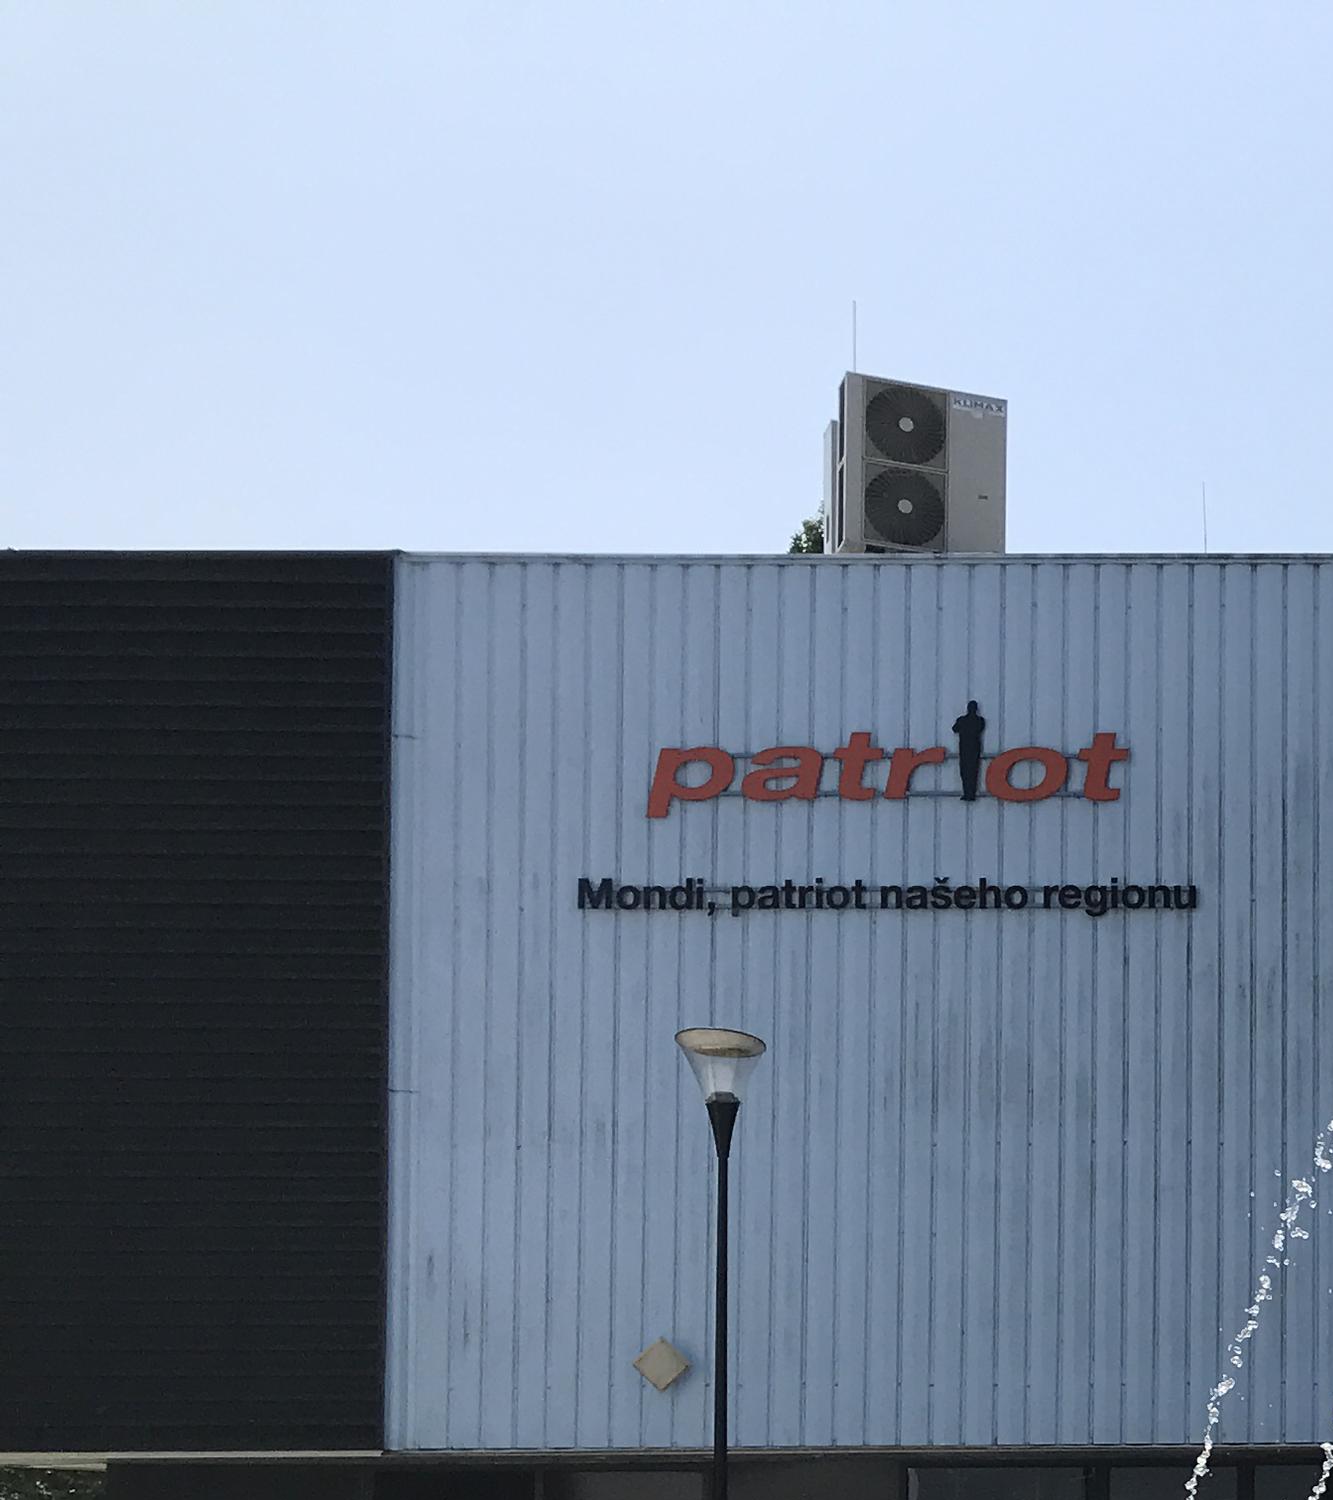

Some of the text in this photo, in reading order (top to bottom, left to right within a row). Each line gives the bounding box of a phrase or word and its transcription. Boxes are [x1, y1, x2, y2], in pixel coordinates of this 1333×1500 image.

[646, 700, 1130, 819] patriot
[577, 877, 1198, 917] Mondi, patriot našeho regionu
